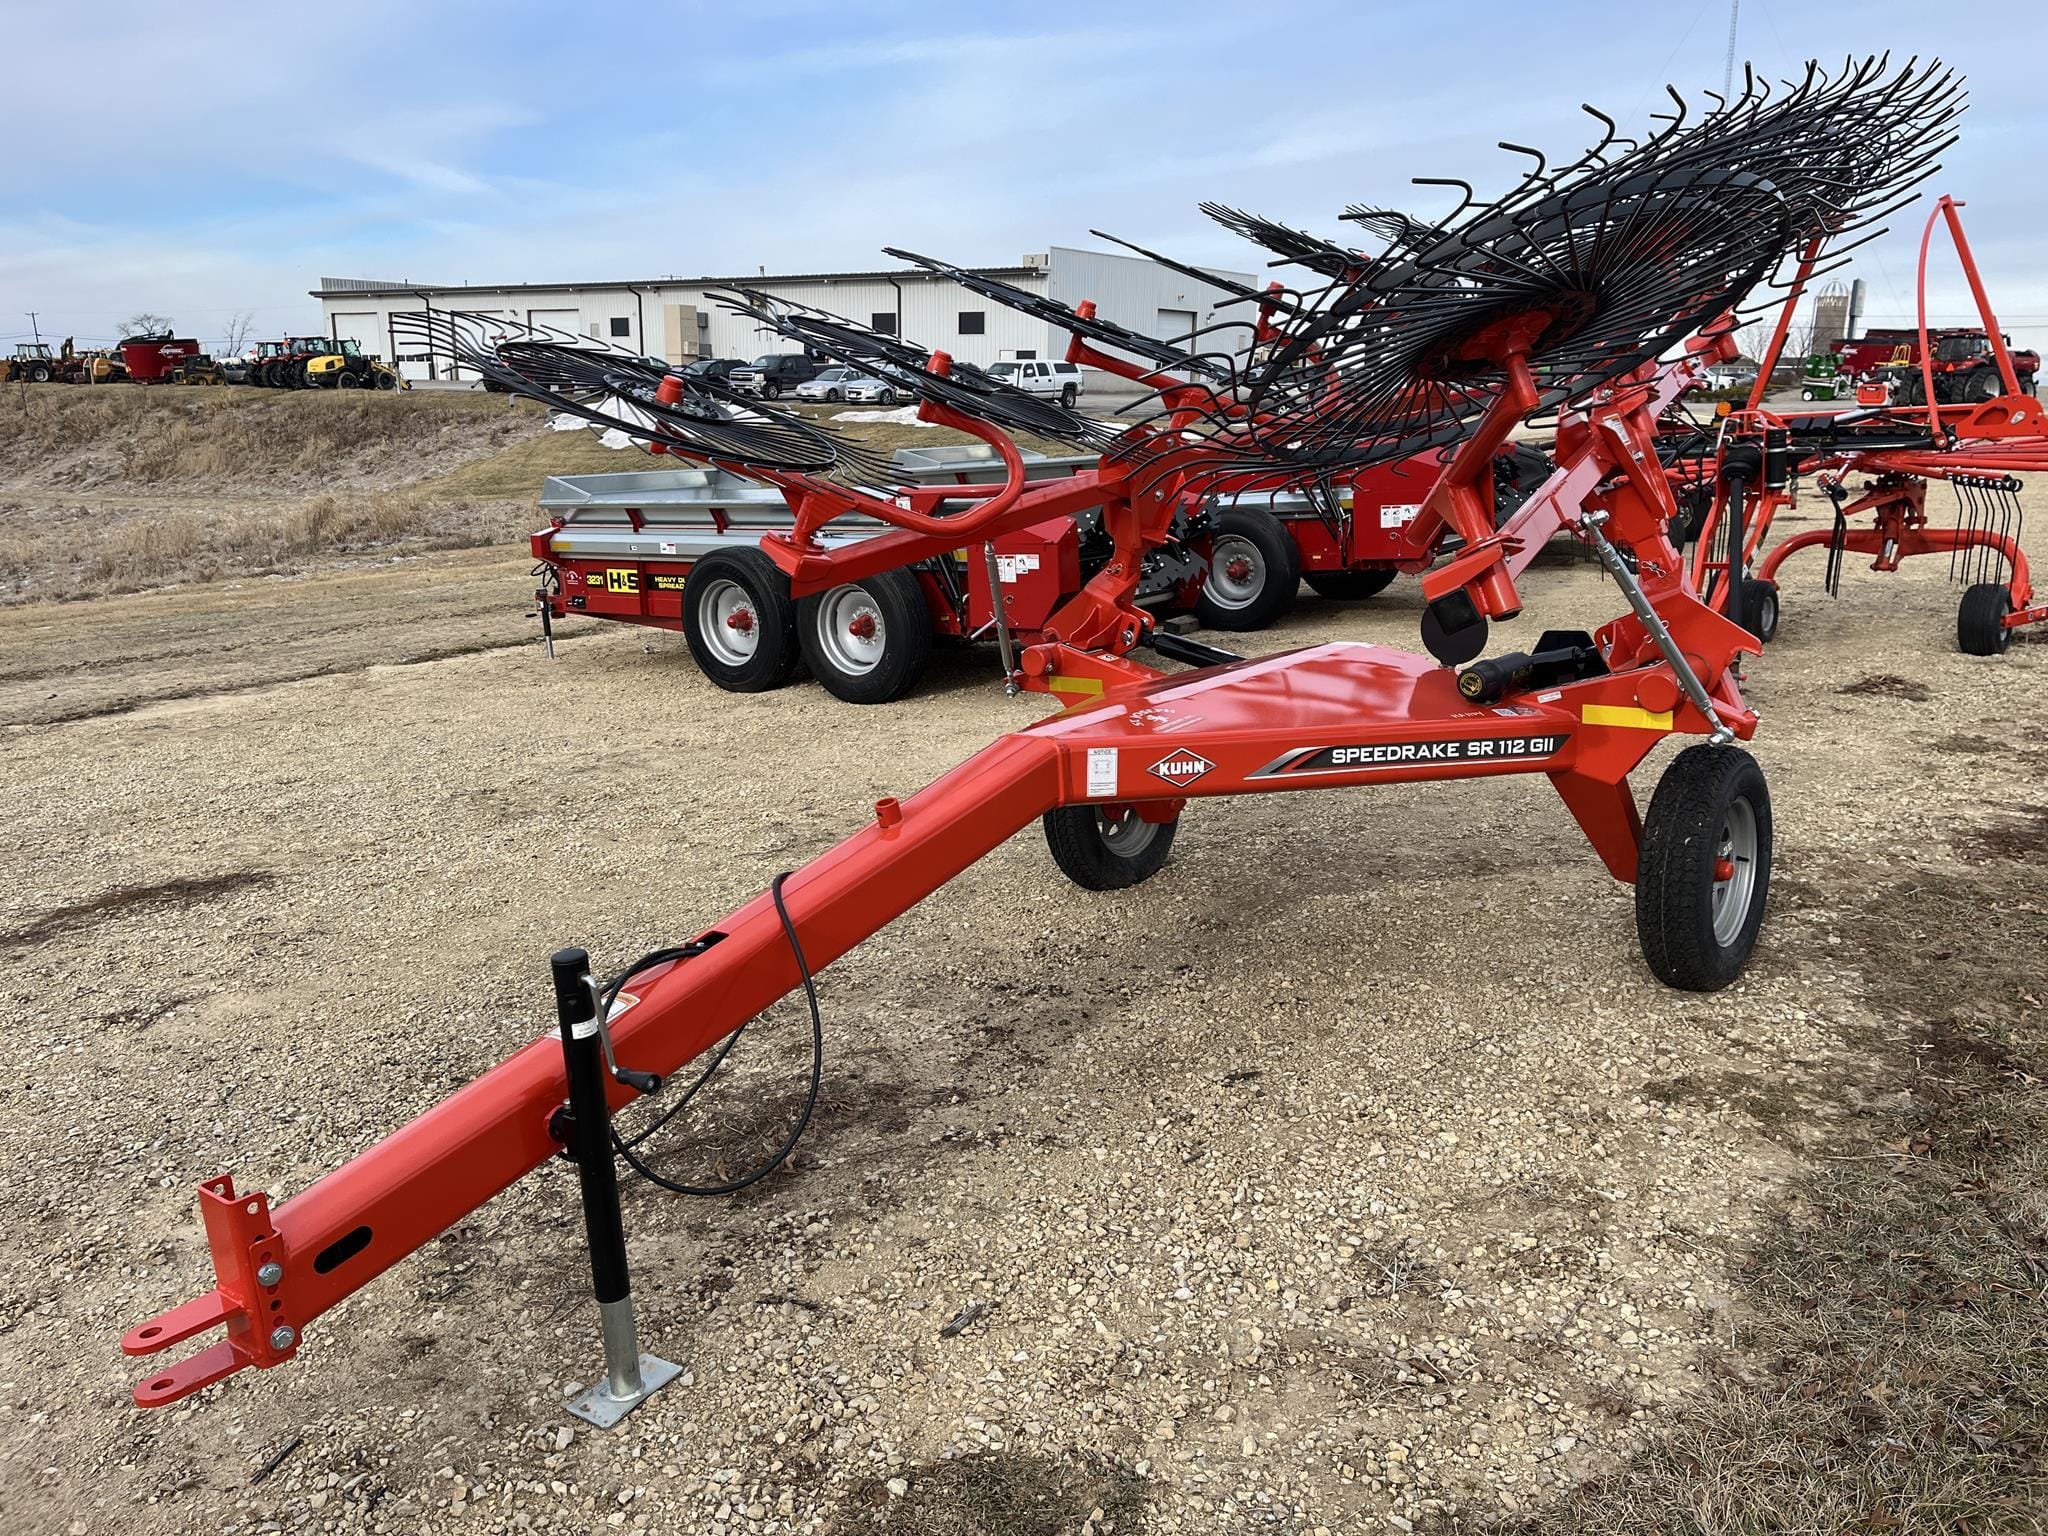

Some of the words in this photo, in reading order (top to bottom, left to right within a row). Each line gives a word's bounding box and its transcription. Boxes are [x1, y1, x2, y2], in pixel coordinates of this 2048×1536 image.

[586, 575, 604, 585] 3231
[1331, 742, 1461, 764] SPEEDRAKE
[1467, 741, 1494, 756] SR
[1498, 738, 1525, 755] 112
[1529, 737, 1554, 753] GII
[1159, 760, 1205, 776] KUHN
